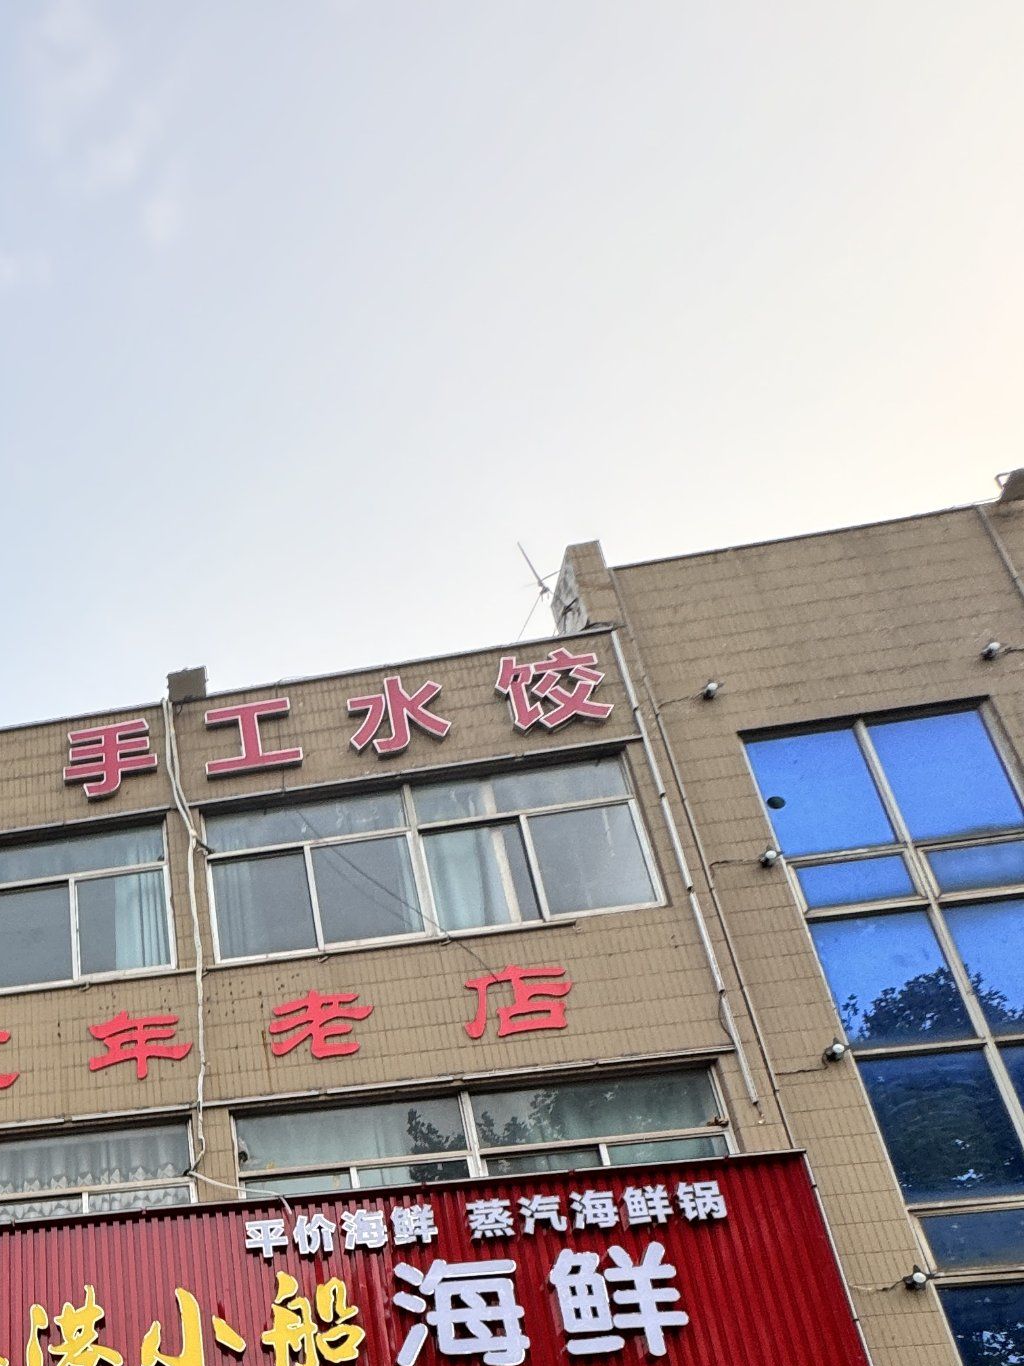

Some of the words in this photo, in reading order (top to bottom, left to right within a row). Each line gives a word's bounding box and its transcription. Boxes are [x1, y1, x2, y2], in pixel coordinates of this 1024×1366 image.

[63, 647, 614, 800] 手工水饺
[245, 1202, 439, 1259] 平价海鲜
[467, 1180, 728, 1240] 蒸汽海鲜锅
